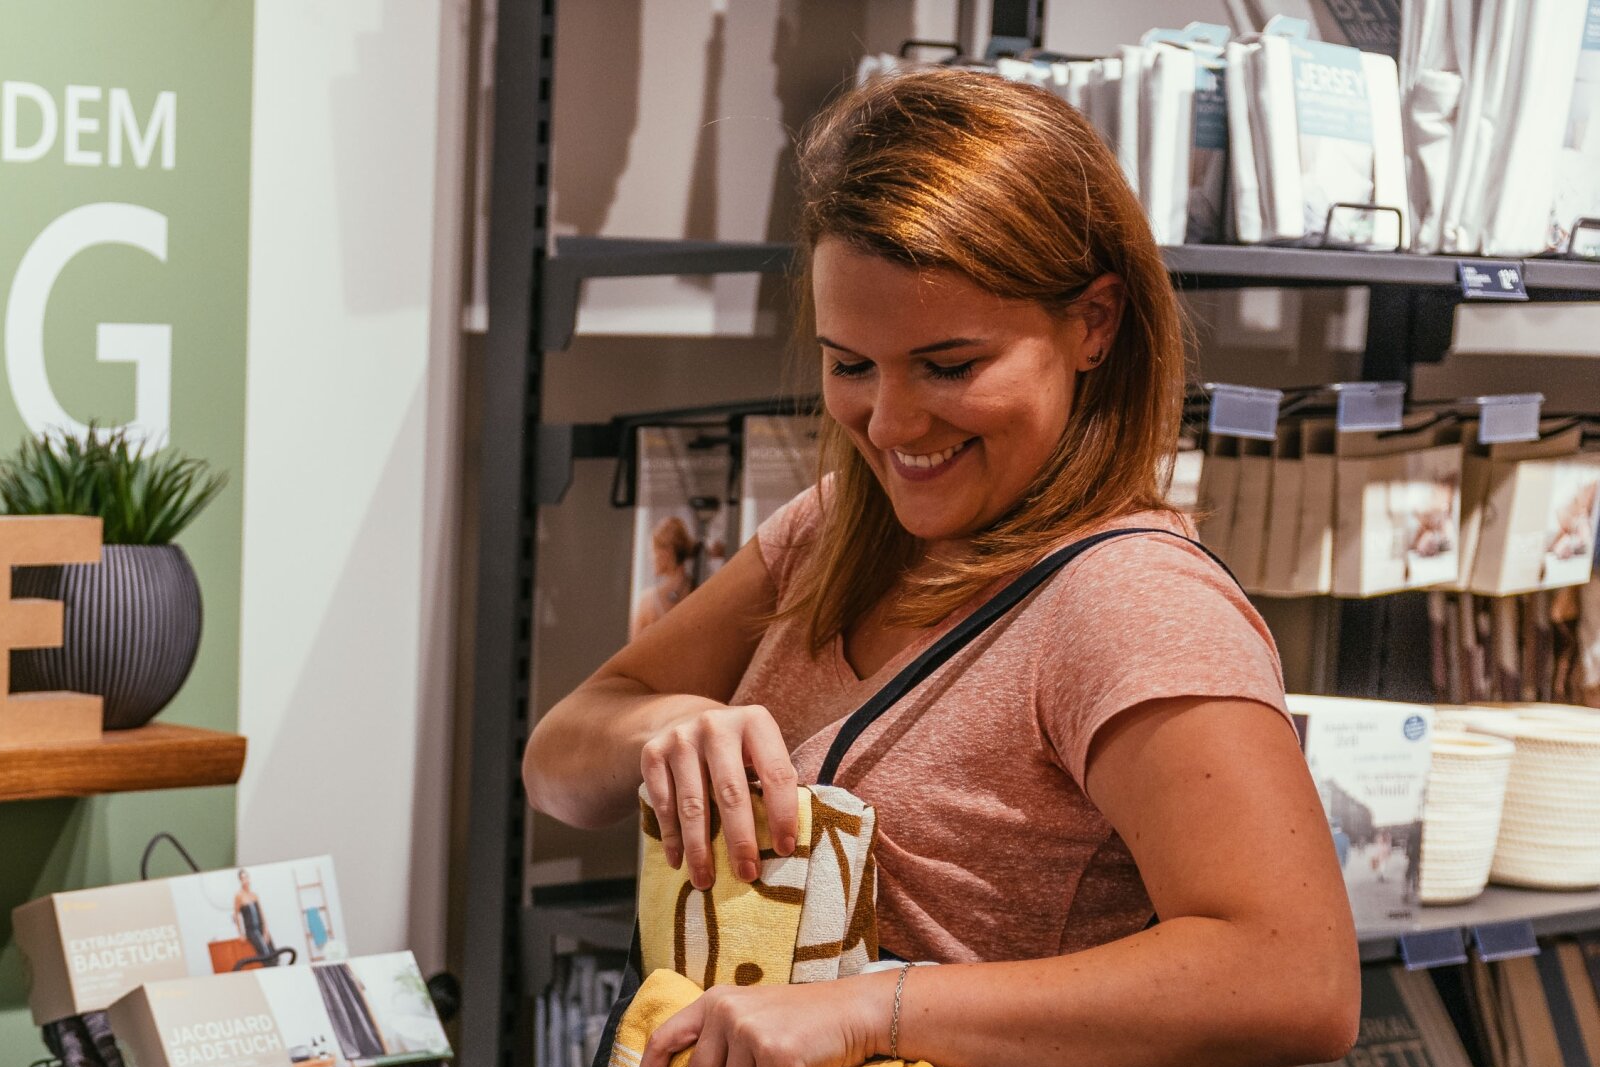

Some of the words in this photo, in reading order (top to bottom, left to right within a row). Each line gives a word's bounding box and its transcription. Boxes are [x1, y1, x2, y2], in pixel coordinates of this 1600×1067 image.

[0, 80, 177, 170] DEM
[72, 941, 181, 974] BADETUCH
[168, 1014, 273, 1046] JACQUARD
[171, 1033, 282, 1067] BADETUCH
